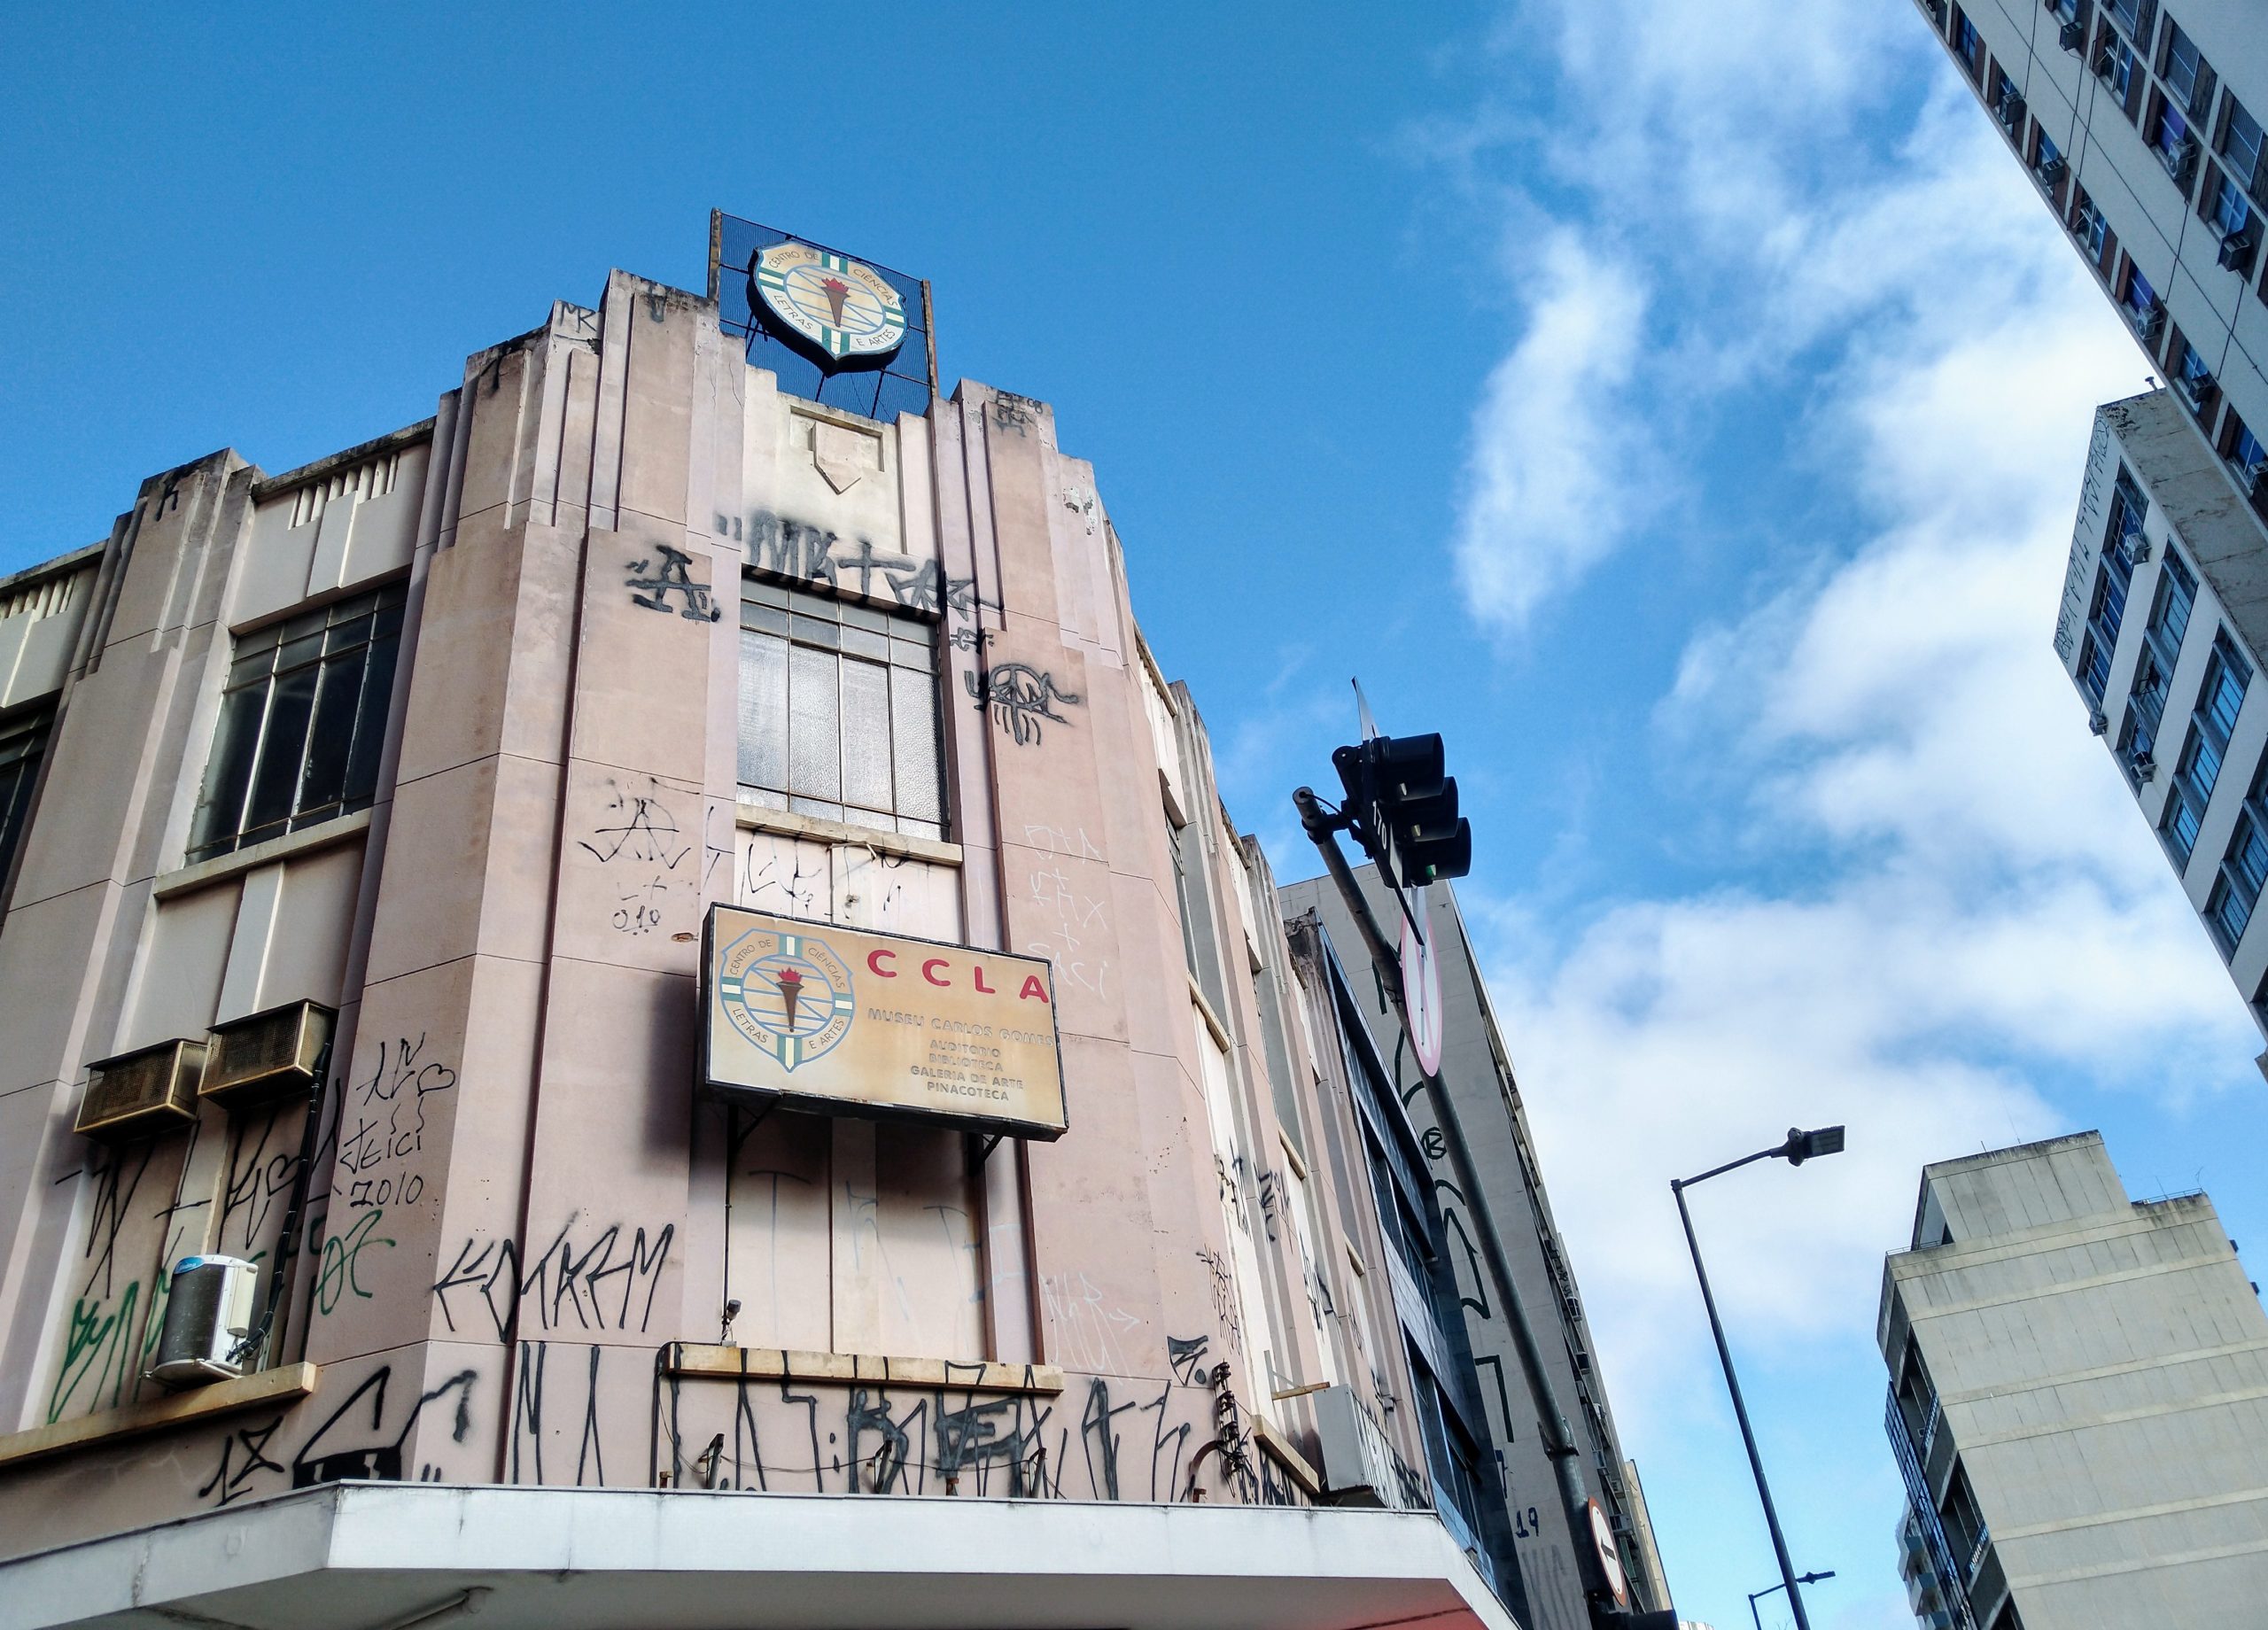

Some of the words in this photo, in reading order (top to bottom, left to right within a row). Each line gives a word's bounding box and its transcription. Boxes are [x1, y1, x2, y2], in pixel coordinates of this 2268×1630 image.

[768, 251, 801, 269] CENTRO
[804, 251, 819, 261] DE
[853, 268, 898, 307] CIÊNCIAS
[773, 294, 813, 330] LETRAS
[856, 338, 865, 347] E
[869, 329, 897, 346] ARTES
[730, 944, 756, 975] CENTRO
[758, 939, 773, 950] DE
[808, 947, 845, 989] CIÊNCIAS
[733, 1008, 769, 1044] LETRAS
[808, 1040, 817, 1050] E
[819, 1019, 845, 1046] ARTES
[868, 1007, 925, 1028] MUSEU
[931, 1018, 993, 1037] CARLOS
[999, 1028, 1055, 1047] GOMES
[928, 1052, 1004, 1073] BIBLIOTECA
[930, 1039, 1001, 1058] AUDITORIO
[910, 1065, 966, 1082] GALERIA
[970, 1074, 987, 1085] DE
[992, 1076, 1024, 1090] ARTE
[927, 1081, 1009, 1101] PINACOTECA
